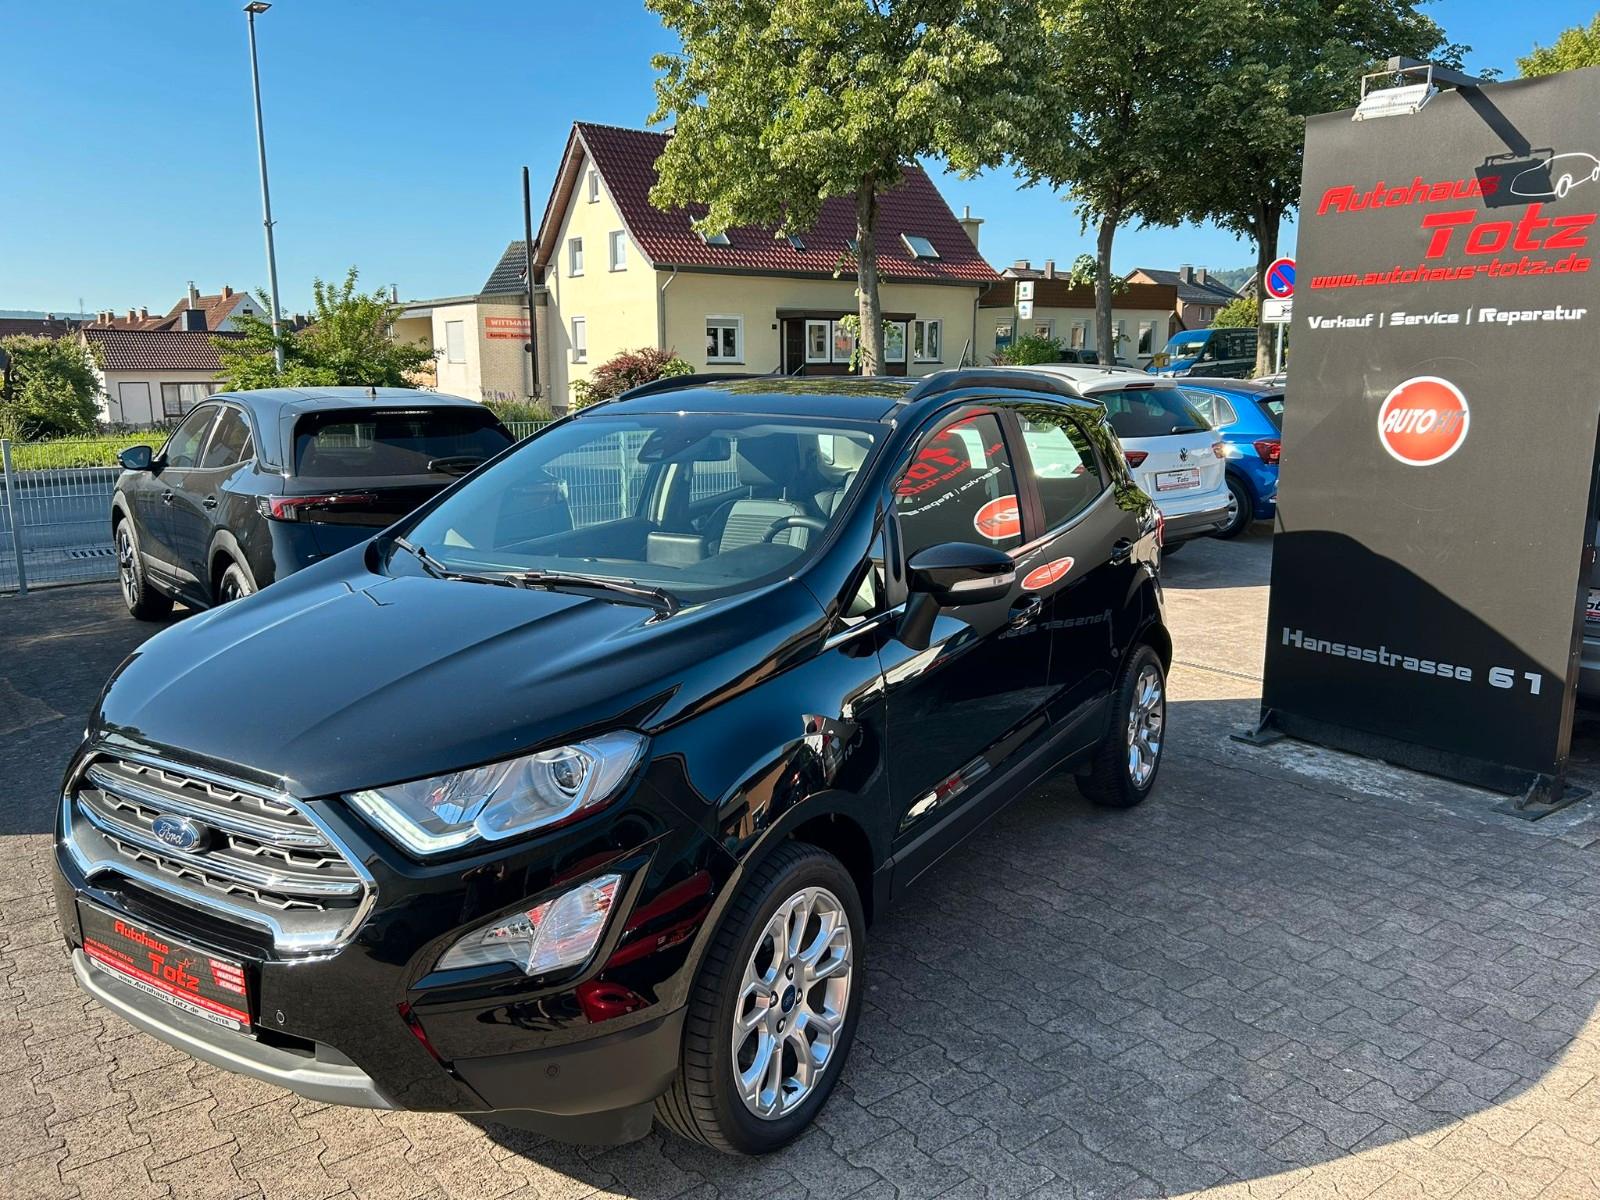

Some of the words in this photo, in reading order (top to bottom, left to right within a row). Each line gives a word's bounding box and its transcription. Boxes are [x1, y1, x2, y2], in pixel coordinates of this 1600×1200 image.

[1316, 176, 1501, 216] Autohaus
[1420, 202, 1598, 258] Totz
[1310, 253, 1592, 289] www.autohaus-totz.de
[1308, 313, 1375, 329] Verkauf
[1390, 311, 1460, 326] Service
[1478, 305, 1588, 325] Reparatur
[1281, 627, 1473, 683] Hansastrasse
[114, 920, 169, 954] Autohaus
[148, 952, 200, 991] Totz
